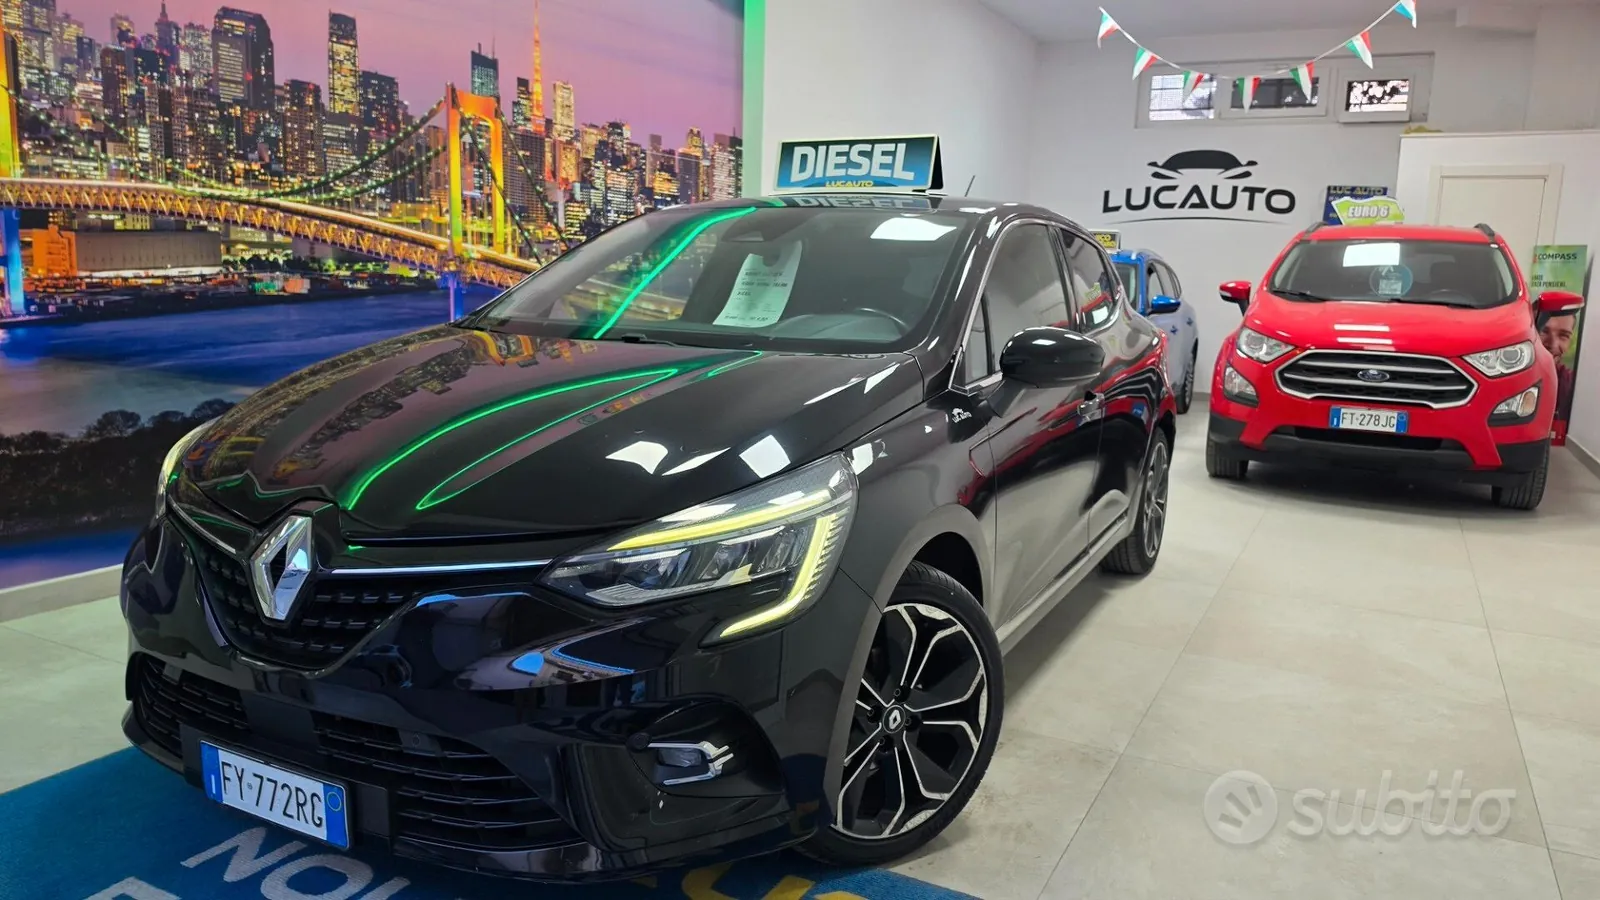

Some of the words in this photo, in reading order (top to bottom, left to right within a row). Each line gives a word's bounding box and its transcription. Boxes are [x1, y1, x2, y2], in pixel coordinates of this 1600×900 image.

[790, 143, 915, 182] DIESEL
[825, 180, 873, 188] LUCAUTO
[1330, 186, 1350, 194] LUC
[1353, 186, 1383, 195] AUTO
[1102, 185, 1296, 214] LUCAUTO
[1348, 205, 1378, 218] EURO
[1379, 206, 1389, 218] 6
[1538, 252, 1577, 260] COMPASS
